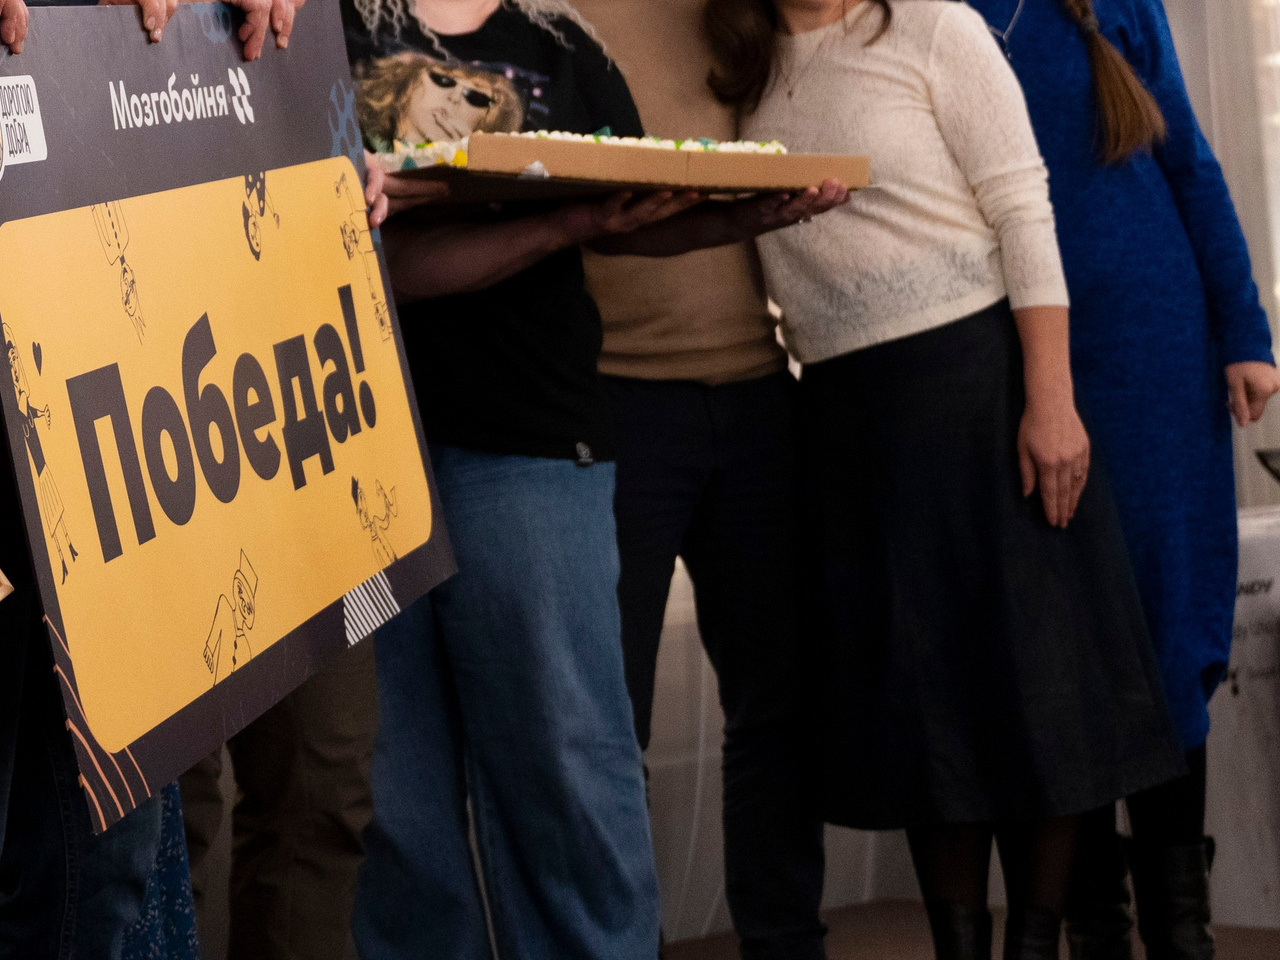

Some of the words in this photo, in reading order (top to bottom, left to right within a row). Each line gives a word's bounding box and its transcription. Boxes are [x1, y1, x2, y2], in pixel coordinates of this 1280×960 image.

[0, 83, 35, 120] ДОРОГОЮ
[108, 72, 228, 131] Мозгобойня
[5, 119, 31, 158] ДОБРА
[65, 283, 377, 564] Победа!
